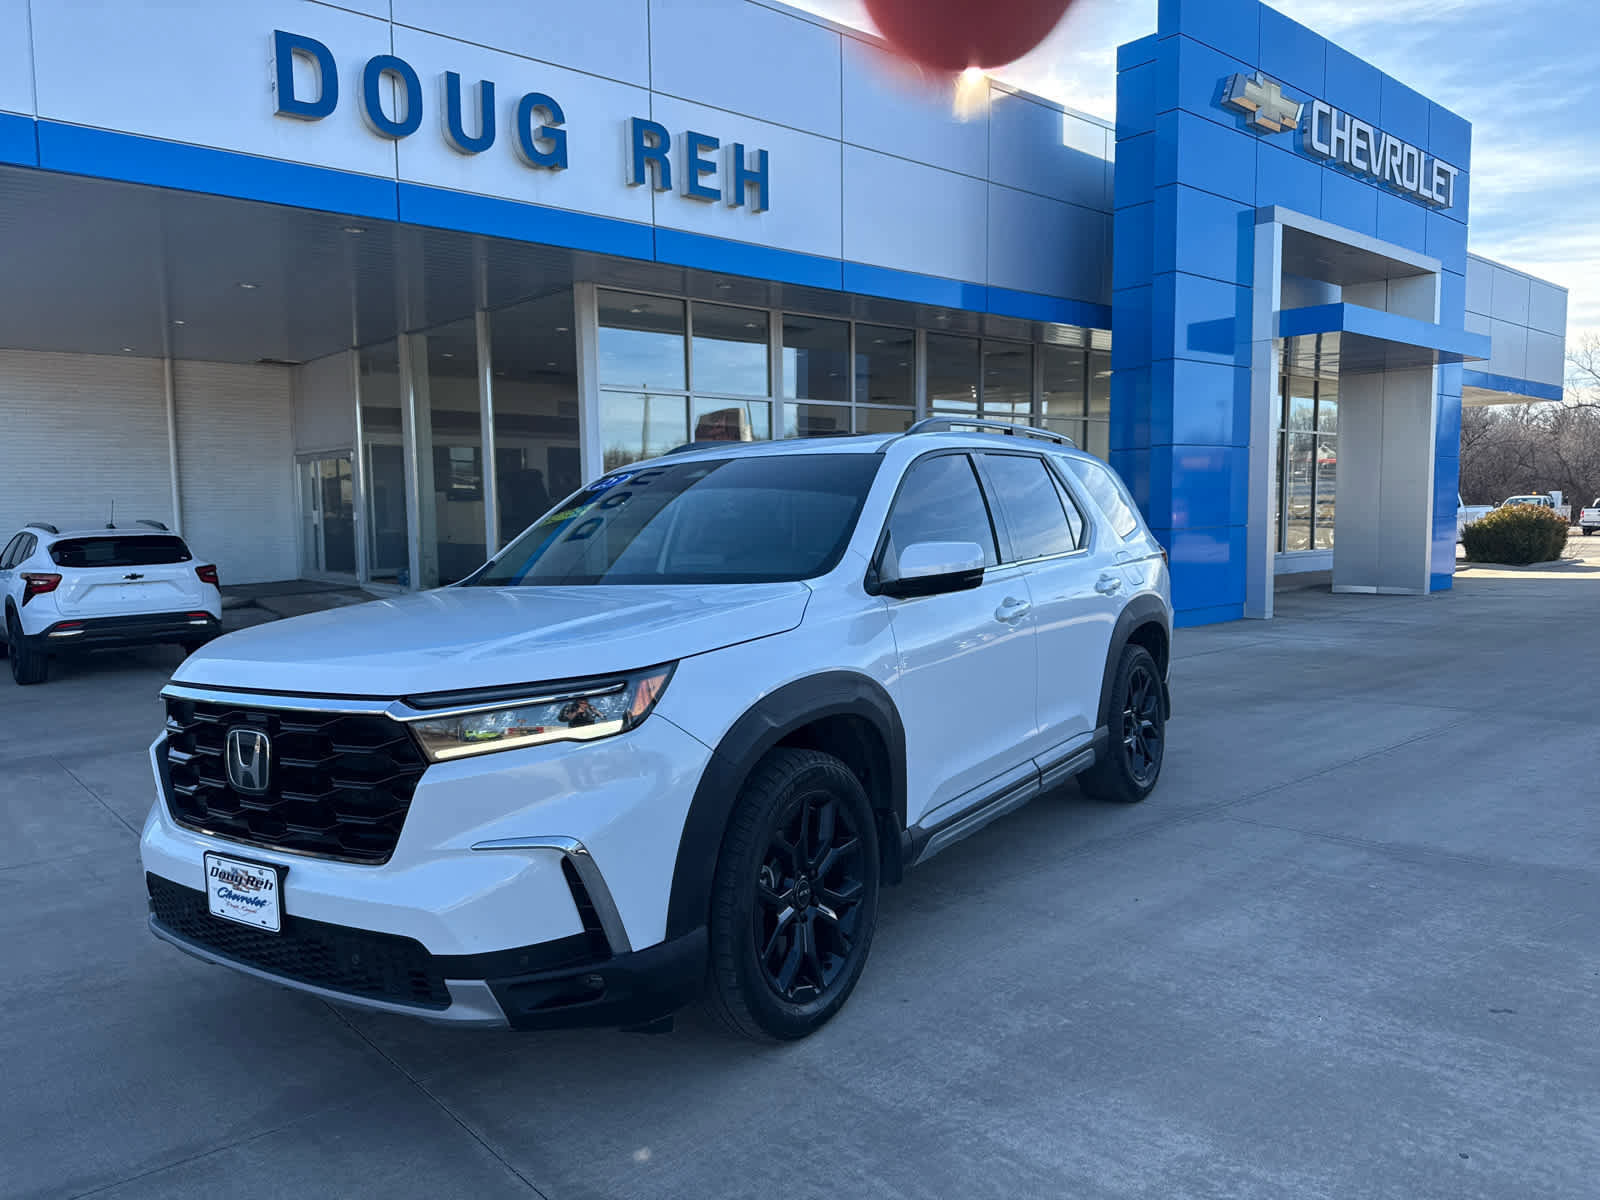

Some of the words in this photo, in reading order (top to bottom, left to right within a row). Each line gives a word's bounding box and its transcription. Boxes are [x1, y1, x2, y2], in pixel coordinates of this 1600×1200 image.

[272, 29, 568, 170] DOUG
[625, 116, 769, 213] REH
[1311, 99, 1459, 208] CHEVROLET
[210, 866, 244, 886] Doug
[246, 875, 274, 891] Reh
[217, 886, 267, 908] Chevrolet
